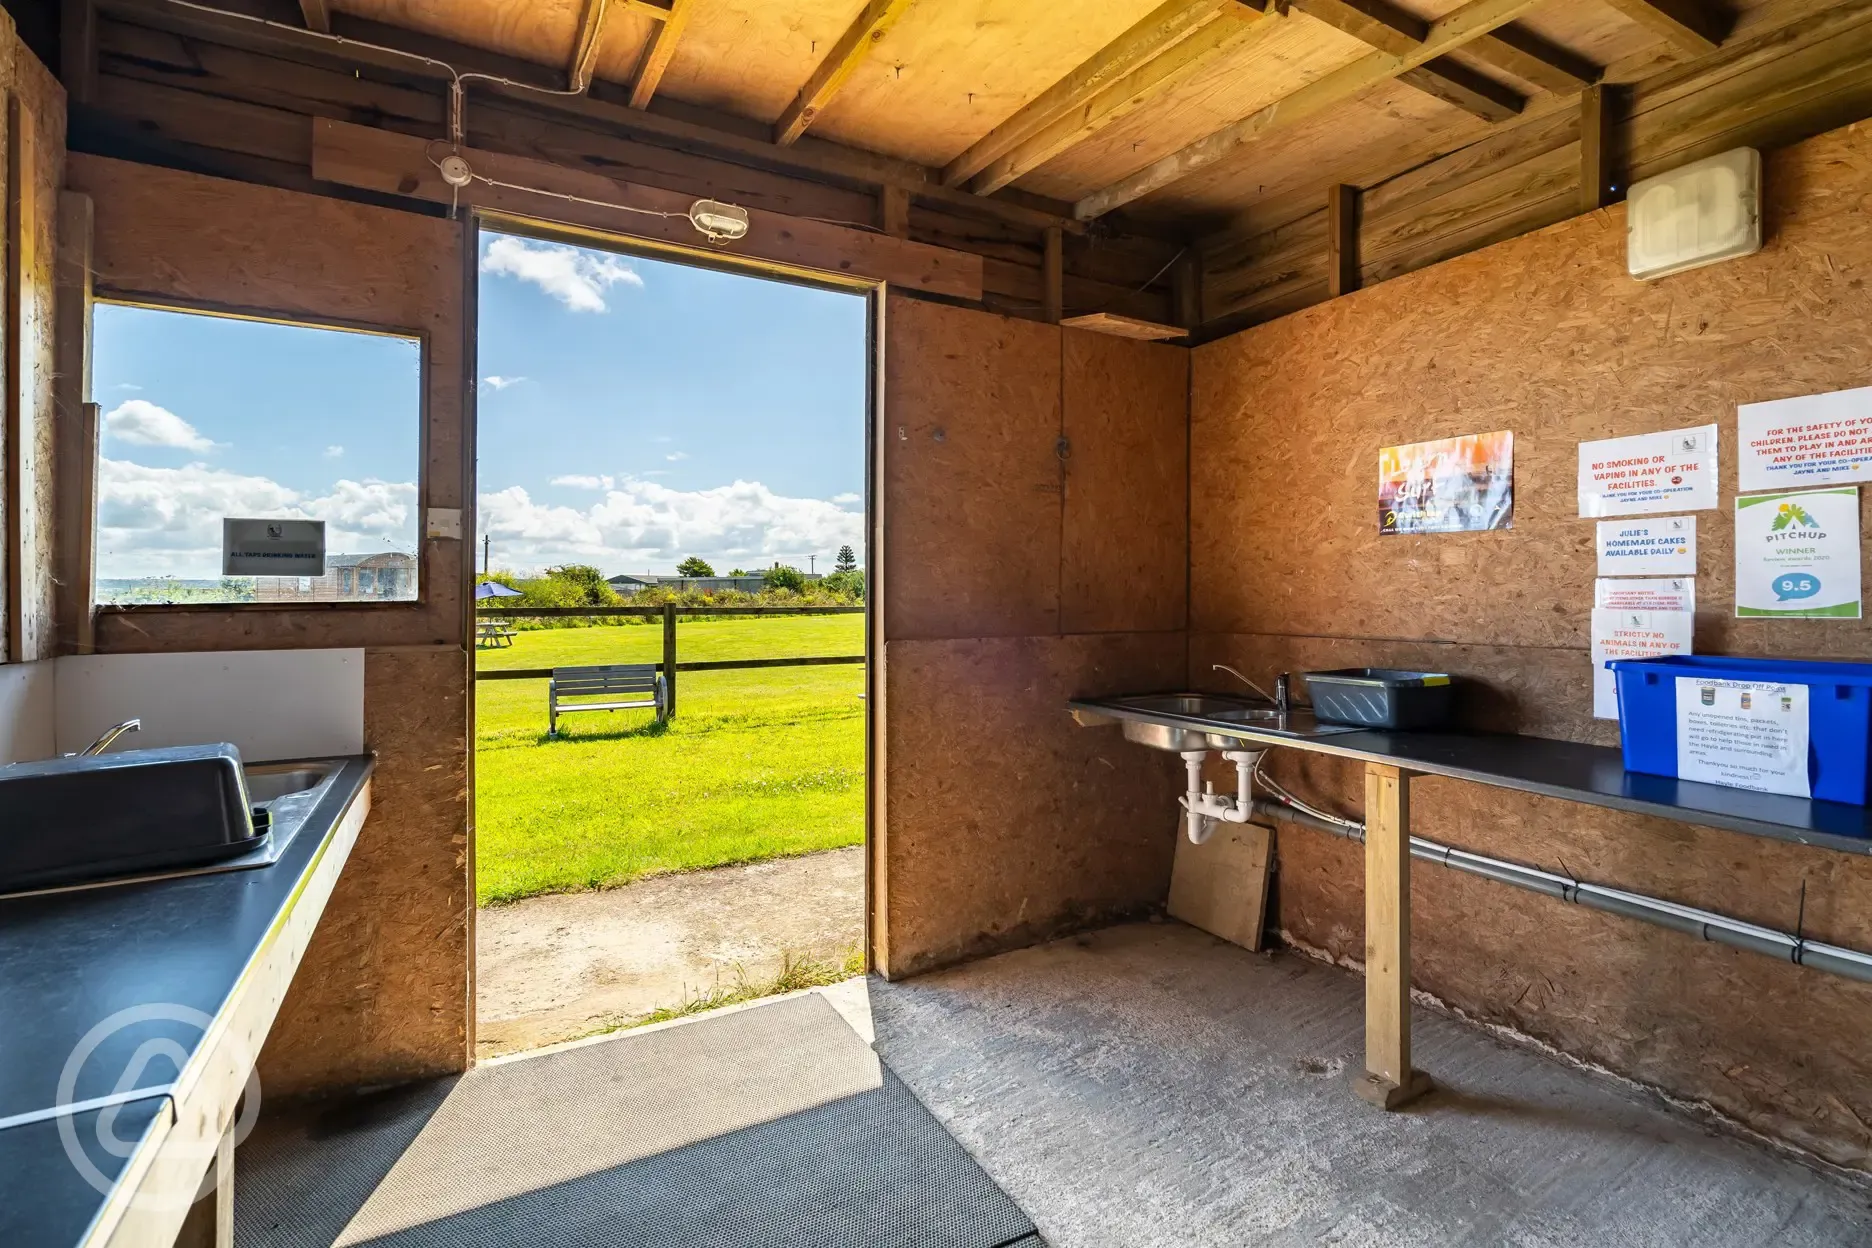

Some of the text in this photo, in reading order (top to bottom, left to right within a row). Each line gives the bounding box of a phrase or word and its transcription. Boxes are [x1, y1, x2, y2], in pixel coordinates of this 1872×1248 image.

[1767, 429, 1783, 437] FOR
[1786, 426, 1803, 434] THE
[1806, 421, 1842, 432] SAFETY
[1751, 436, 1796, 448] CHILDREN.
[1798, 432, 1831, 442] PLEASE
[1849, 428, 1869, 436] NOT
[1756, 448, 1782, 456] THEM
[1799, 443, 1822, 451] PLAY
[1837, 439, 1857, 447] AND
[1592, 455, 1665, 471] NO SMOKING OR
[1594, 463, 1699, 481] VAPING IN ANY OF THE
[1608, 480, 1657, 490] FACILITIES.
[1619, 529, 1649, 537] JULIE'S
[1766, 532, 1827, 542] PITCHUP
[1606, 537, 1686, 547] HOMEMADE CAKES
[1605, 549, 1648, 557] AVAILABLE
[1782, 580, 1812, 591] 9.5
[1696, 679, 1731, 687] Foodbank
[1732, 682, 1751, 690] Drop
[1702, 713, 1734, 721] unopened
[1750, 718, 1779, 726] packets,
[1710, 721, 1738, 729] toiletries
[1734, 739, 1752, 747] those
[1734, 747, 1773, 758] surrounding
[1698, 759, 1728, 769] Thankyou
[1715, 780, 1768, 792] Hayle Foodbank
